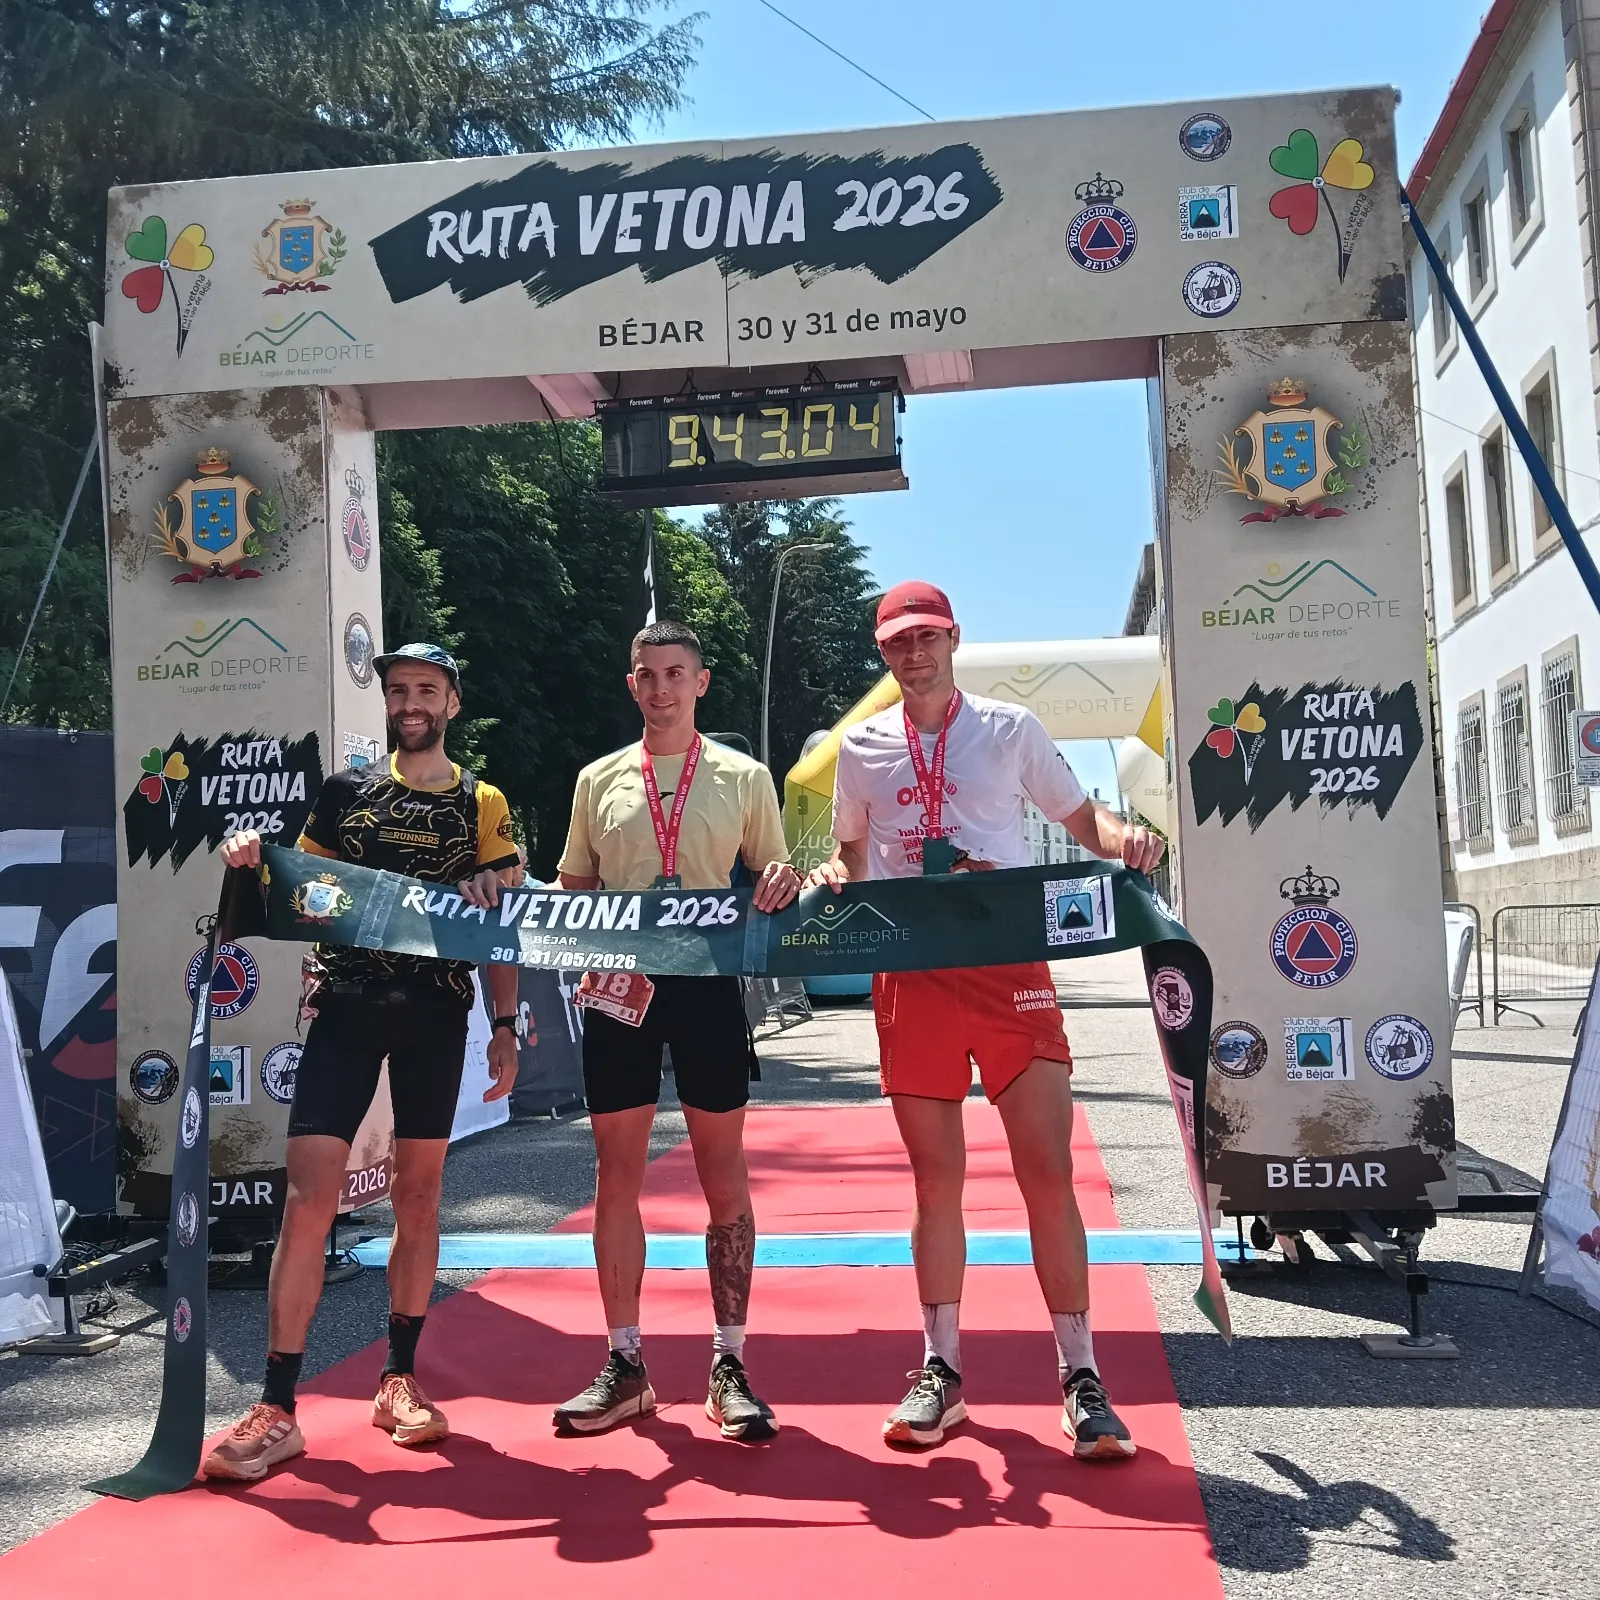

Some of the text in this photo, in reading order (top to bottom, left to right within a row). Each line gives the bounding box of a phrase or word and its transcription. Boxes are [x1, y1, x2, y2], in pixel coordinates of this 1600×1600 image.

[426, 172, 971, 262] RUTA VETONA 2026
[1180, 201, 1189, 231] SIERRA
[1347, 192, 1367, 228] vetona
[1069, 207, 1134, 248] PROTECCION CIVIL
[1083, 257, 1122, 271] BEJAR
[187, 274, 206, 307] vetona
[599, 304, 968, 347] BÉJAR 30 y 31 de mayo
[219, 343, 374, 367] BÉJAR DEPORTE
[285, 368, 295, 376] de
[297, 368, 310, 376] tus
[1202, 599, 1401, 628] BÉJAR DEPORTE
[1287, 629, 1300, 639] de
[1303, 629, 1319, 638] tus
[137, 654, 308, 682] BÉJAR DEPORTE
[209, 683, 220, 692] de
[222, 683, 236, 691] tus
[1036, 696, 1134, 716] DEPORTE
[1303, 690, 1375, 722] RUTA
[220, 740, 283, 769] RUTA
[1281, 724, 1404, 761] VETONA
[201, 771, 306, 806] VETONA
[1308, 765, 1380, 794] 2026
[223, 809, 285, 837] 2026
[393, 831, 440, 845] RUNNERS
[1067, 879, 1080, 887] de
[402, 886, 740, 931] RUTA VETONA 2026
[1046, 898, 1057, 934] SIERRA
[533, 934, 578, 946] BÉJAR
[781, 927, 911, 946] BÉJAR DEPORTE
[1048, 930, 1095, 944] de Béjar
[1274, 909, 1354, 957] PROTECCION CIVIL
[490, 946, 636, 970] 30 y 31/05/2026
[847, 947, 858, 955] tus
[241, 956, 256, 989] CIVIL
[1293, 970, 1339, 986] BEJAR
[211, 1002, 242, 1016] EJAR
[1284, 1016, 1319, 1026] club de
[1286, 1034, 1297, 1069] SIERRA
[1287, 1069, 1334, 1081] de Béjar
[349, 1165, 386, 1198] 2026
[1266, 1157, 1388, 1188] BÉJAR
[212, 1182, 274, 1206] JAR
